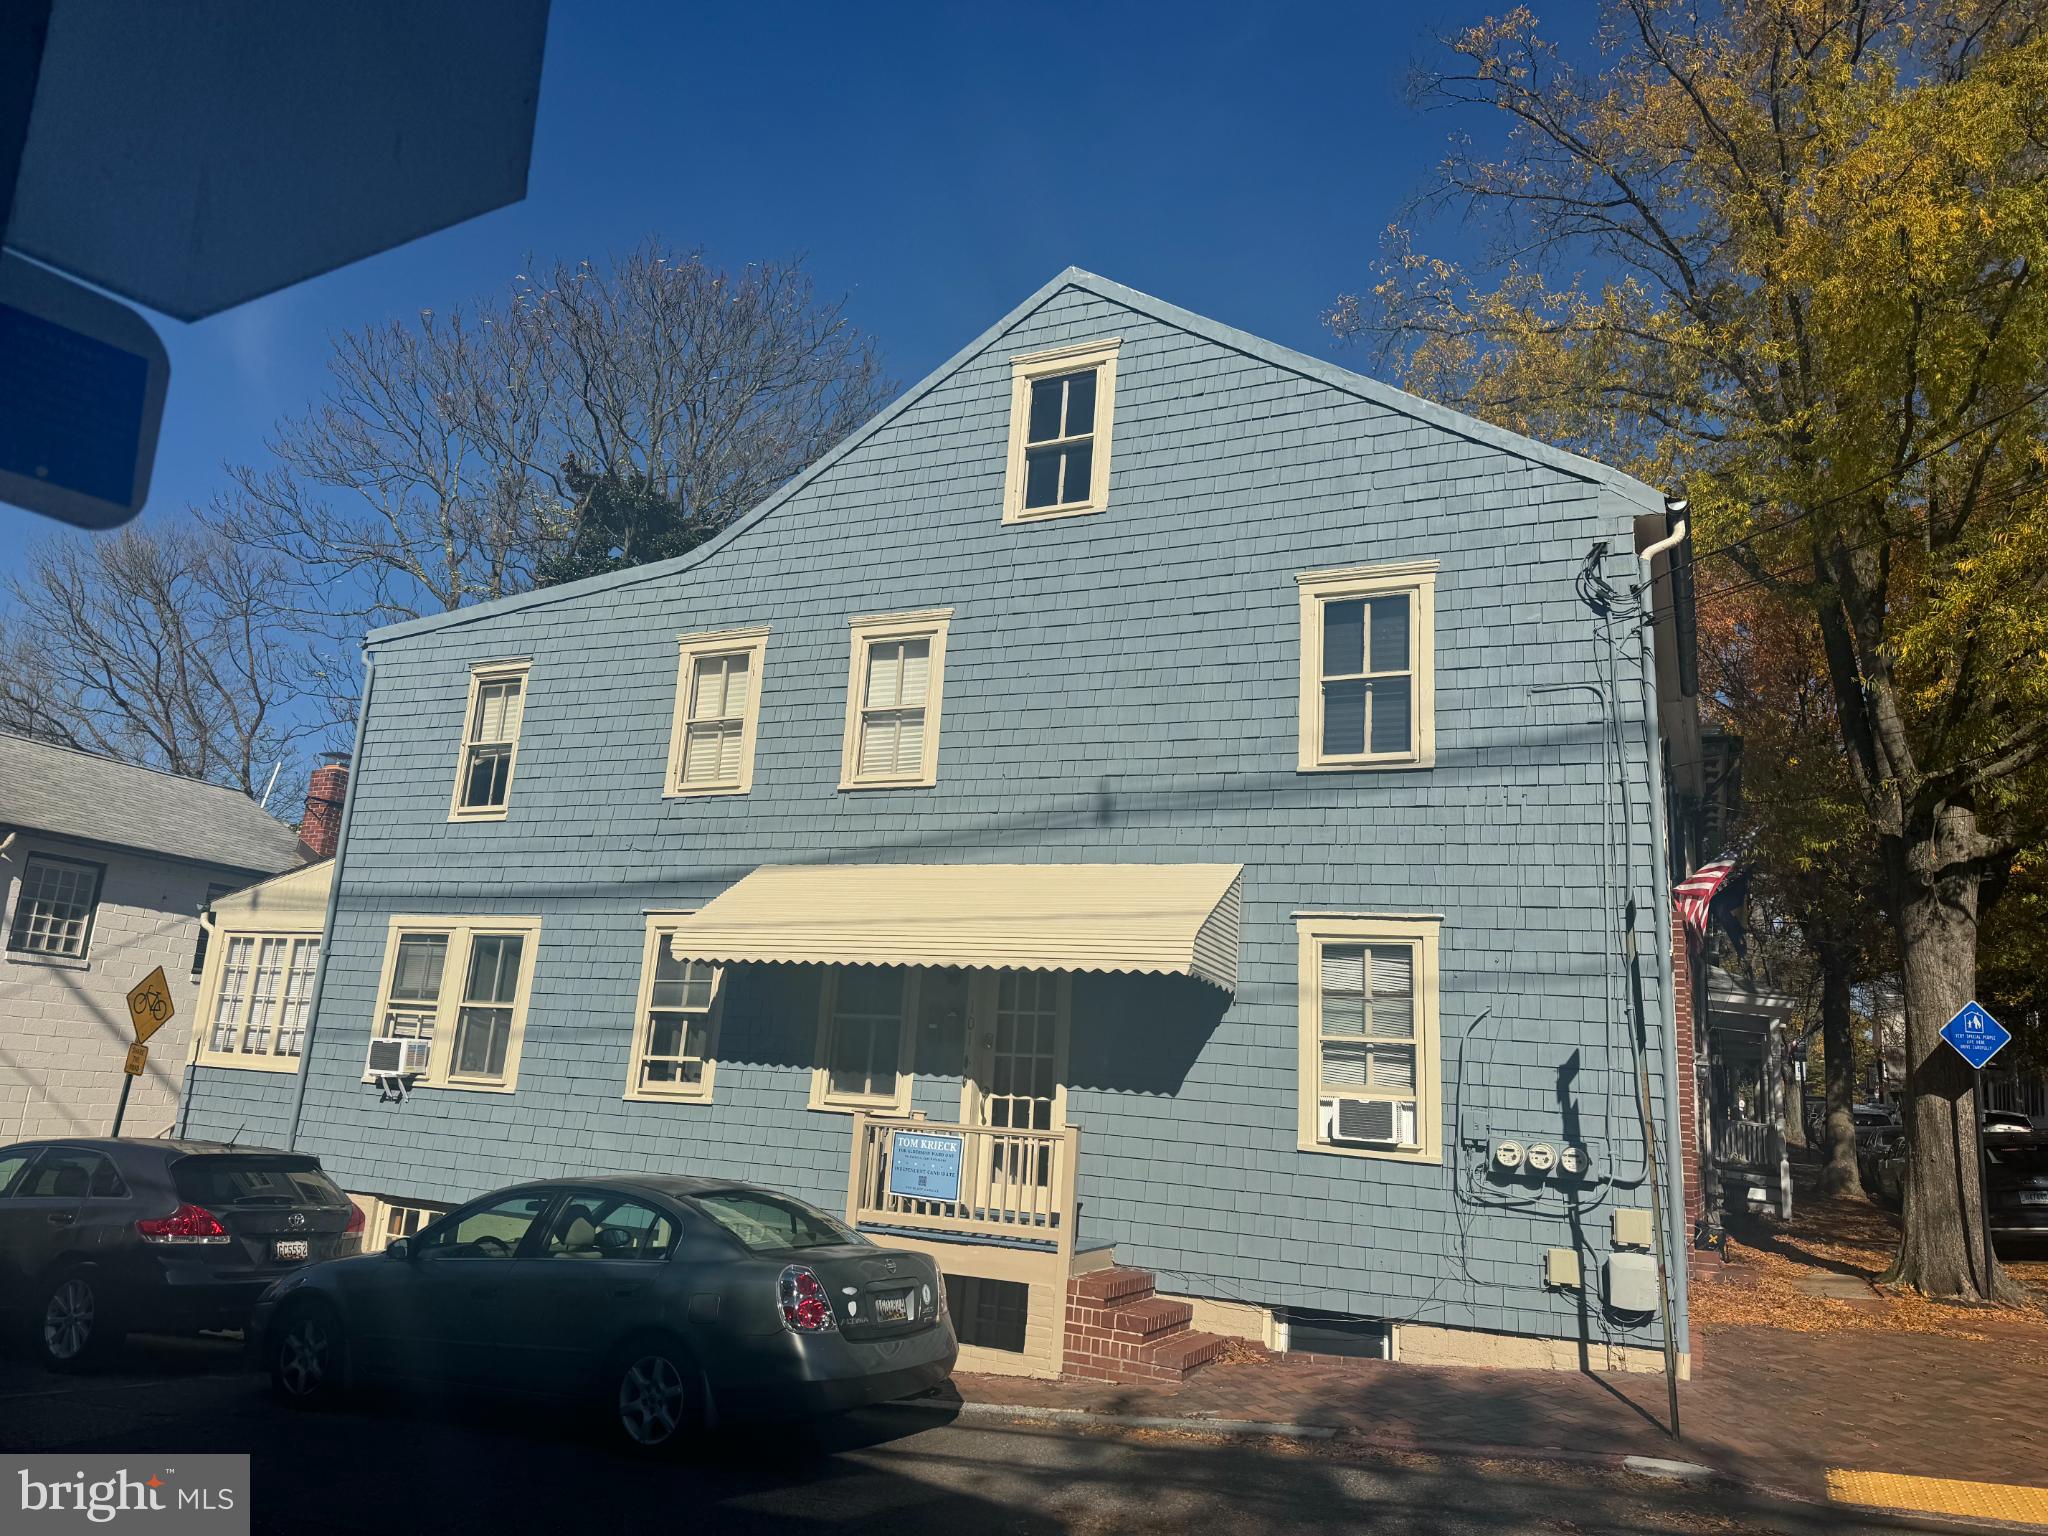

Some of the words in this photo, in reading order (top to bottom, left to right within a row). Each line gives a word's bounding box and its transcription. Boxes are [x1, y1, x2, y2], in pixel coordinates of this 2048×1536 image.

[897, 1137, 919, 1148] TOM
[920, 1139, 957, 1152] KRIECK
[926, 1170, 956, 1178] CANDIDATE
